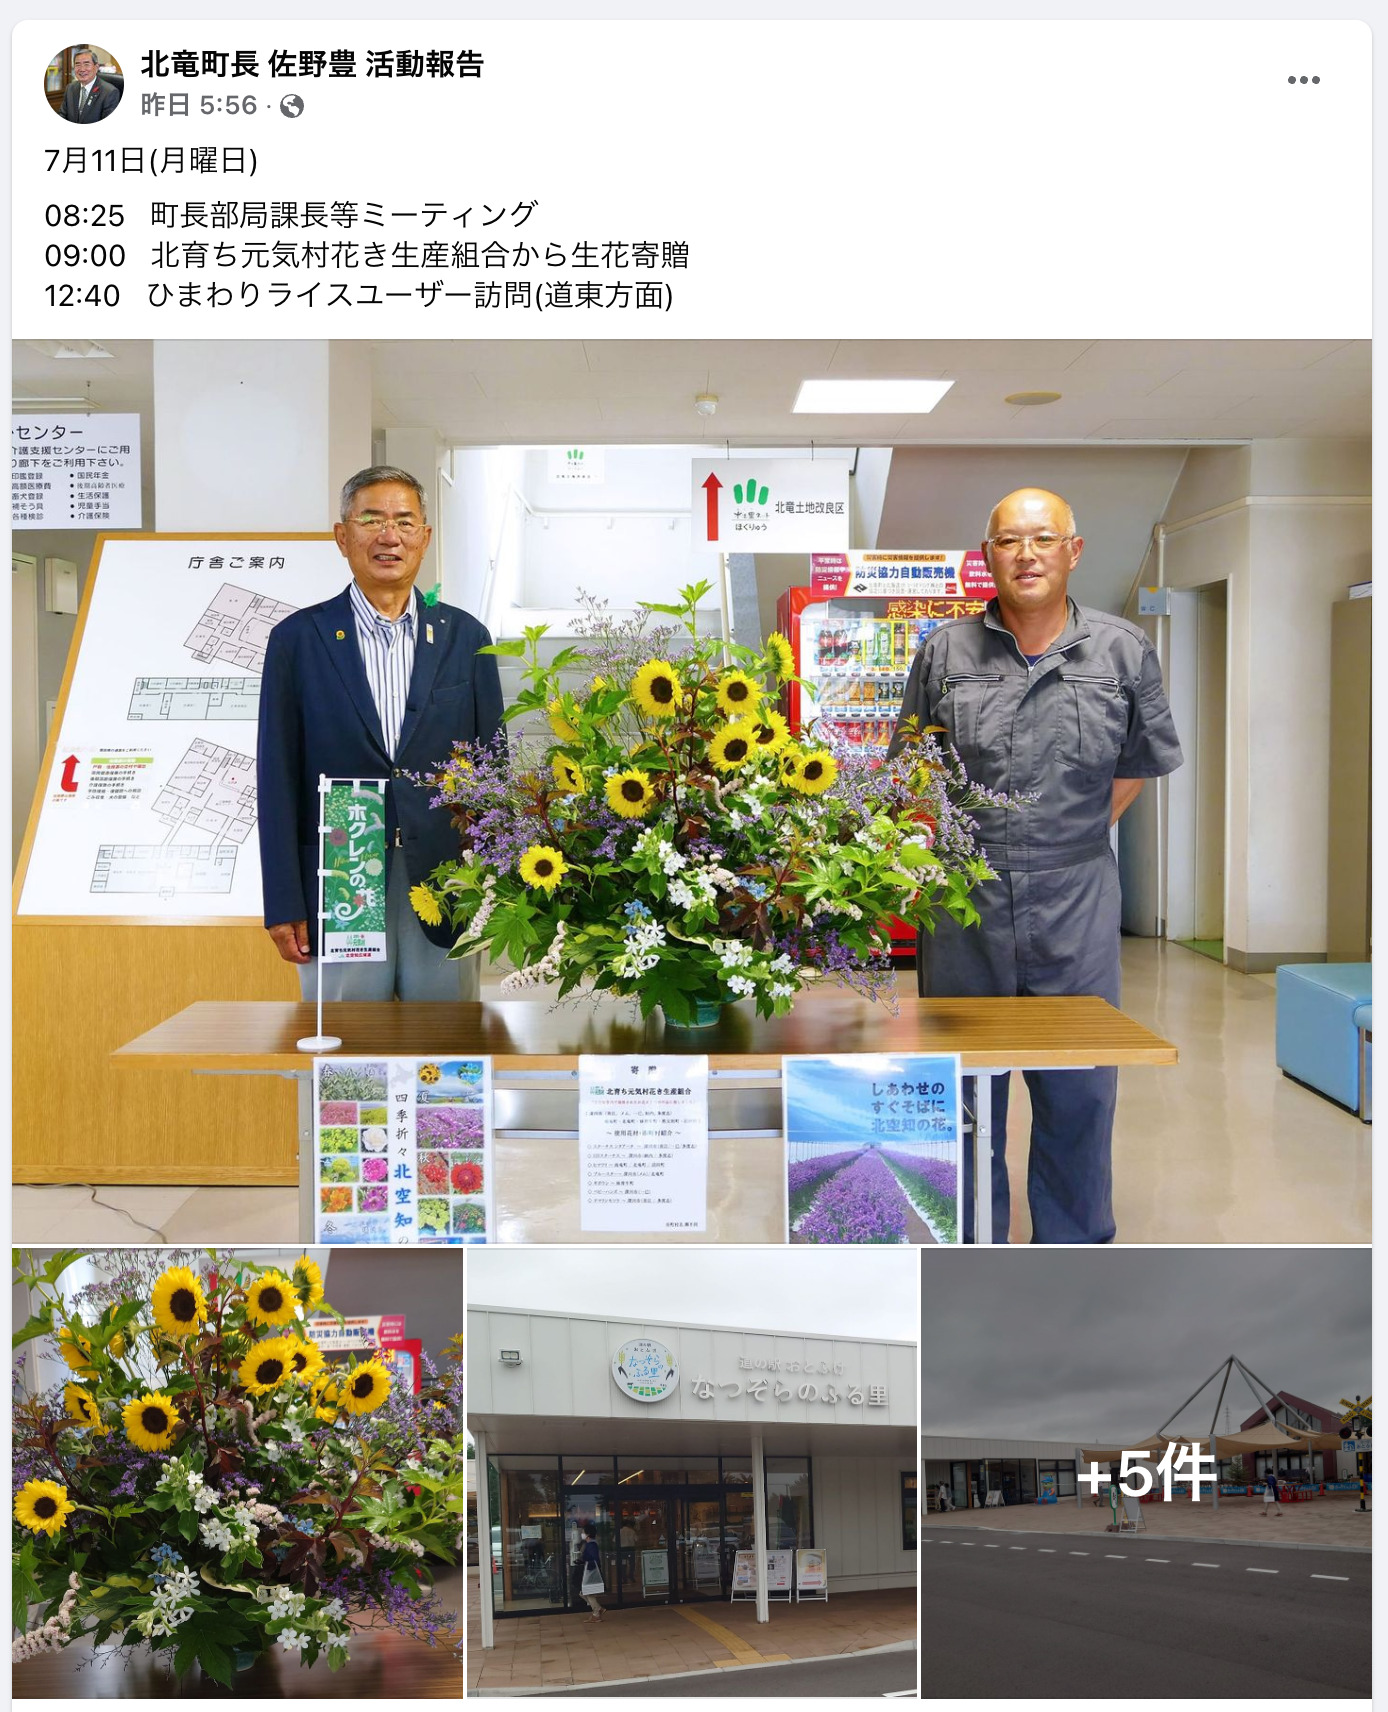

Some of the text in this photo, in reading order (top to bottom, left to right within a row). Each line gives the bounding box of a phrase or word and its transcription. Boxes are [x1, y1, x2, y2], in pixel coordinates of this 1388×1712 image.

[12, 425, 83, 440] センター
[77, 472, 109, 480] 国民年金
[78, 492, 110, 500] 生活保護
[78, 502, 110, 510] 児童手当
[775, 500, 845, 514] 北竜土地改良区
[78, 512, 110, 520] 介護保険
[735, 523, 768, 531] ほくりゅう
[188, 556, 286, 569] 庁舎ご案内
[855, 566, 956, 580] 防災協力自動販売機
[345, 804, 376, 909] ホクレンの花
[606, 1088, 692, 1096] 北育ち元気村花き生産組合
[871, 1082, 945, 1097] しあわせの
[871, 1100, 945, 1114] すぐそばに
[871, 1118, 953, 1133] 北空知の花。
[739, 1357, 844, 1376] 道の駅 おとふけ
[691, 1374, 889, 1406] なつぞらのふる里
